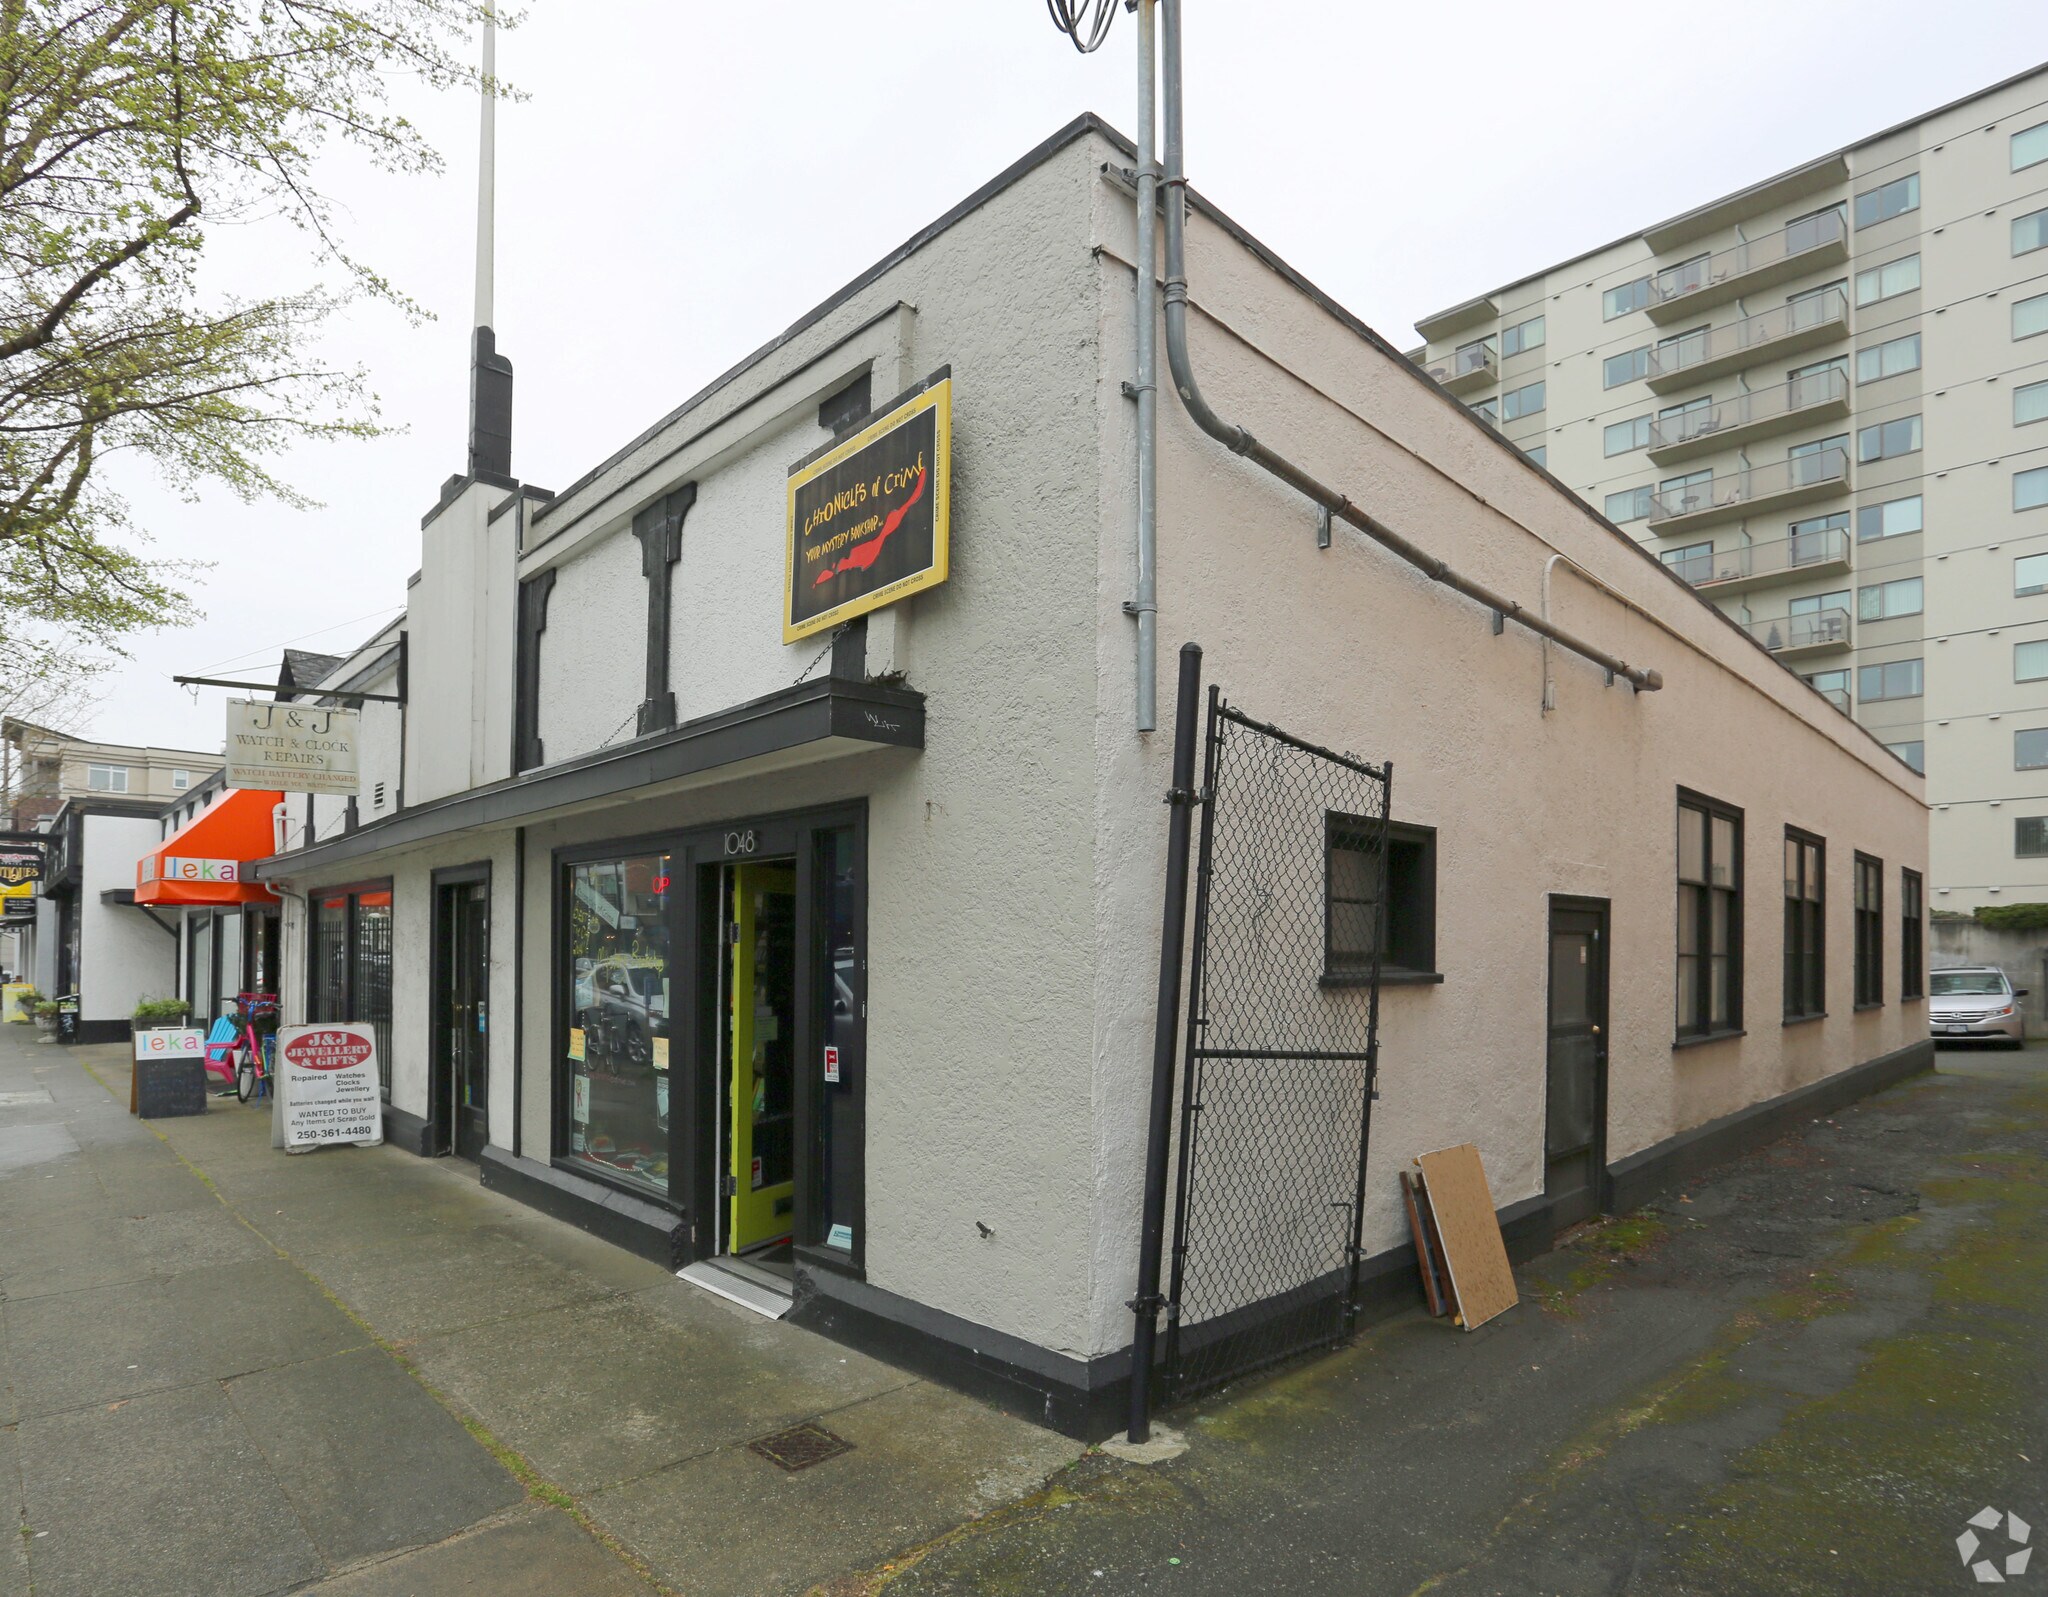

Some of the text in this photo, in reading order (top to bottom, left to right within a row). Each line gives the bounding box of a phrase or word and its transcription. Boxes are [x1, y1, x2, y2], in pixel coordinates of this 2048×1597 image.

[872, 476, 881, 498] of
[805, 514, 880, 564] YOUR MYSTERY BOOKSHOP
[902, 579, 910, 587] NOT
[911, 574, 924, 584] CROSS
[253, 704, 332, 734] J & J
[236, 734, 349, 752] WATCH & CLOCK
[264, 751, 324, 764] REPAIRS
[232, 768, 357, 783] WATCH BATTERY CHANGED
[724, 830, 755, 855] 1048
[173, 858, 235, 880] leka
[143, 1033, 199, 1052] leka
[308, 1033, 348, 1046] J&J
[287, 1045, 370, 1058] JEWELLERY
[301, 1055, 358, 1067] & GIFTS
[291, 1074, 328, 1082] Repaired
[336, 1086, 370, 1094] Jewellery
[299, 1110, 334, 1118] WANTED
[351, 1107, 367, 1115] BUY
[336, 1116, 358, 1124] Scrap
[296, 1126, 372, 1140] 250-361-4480
